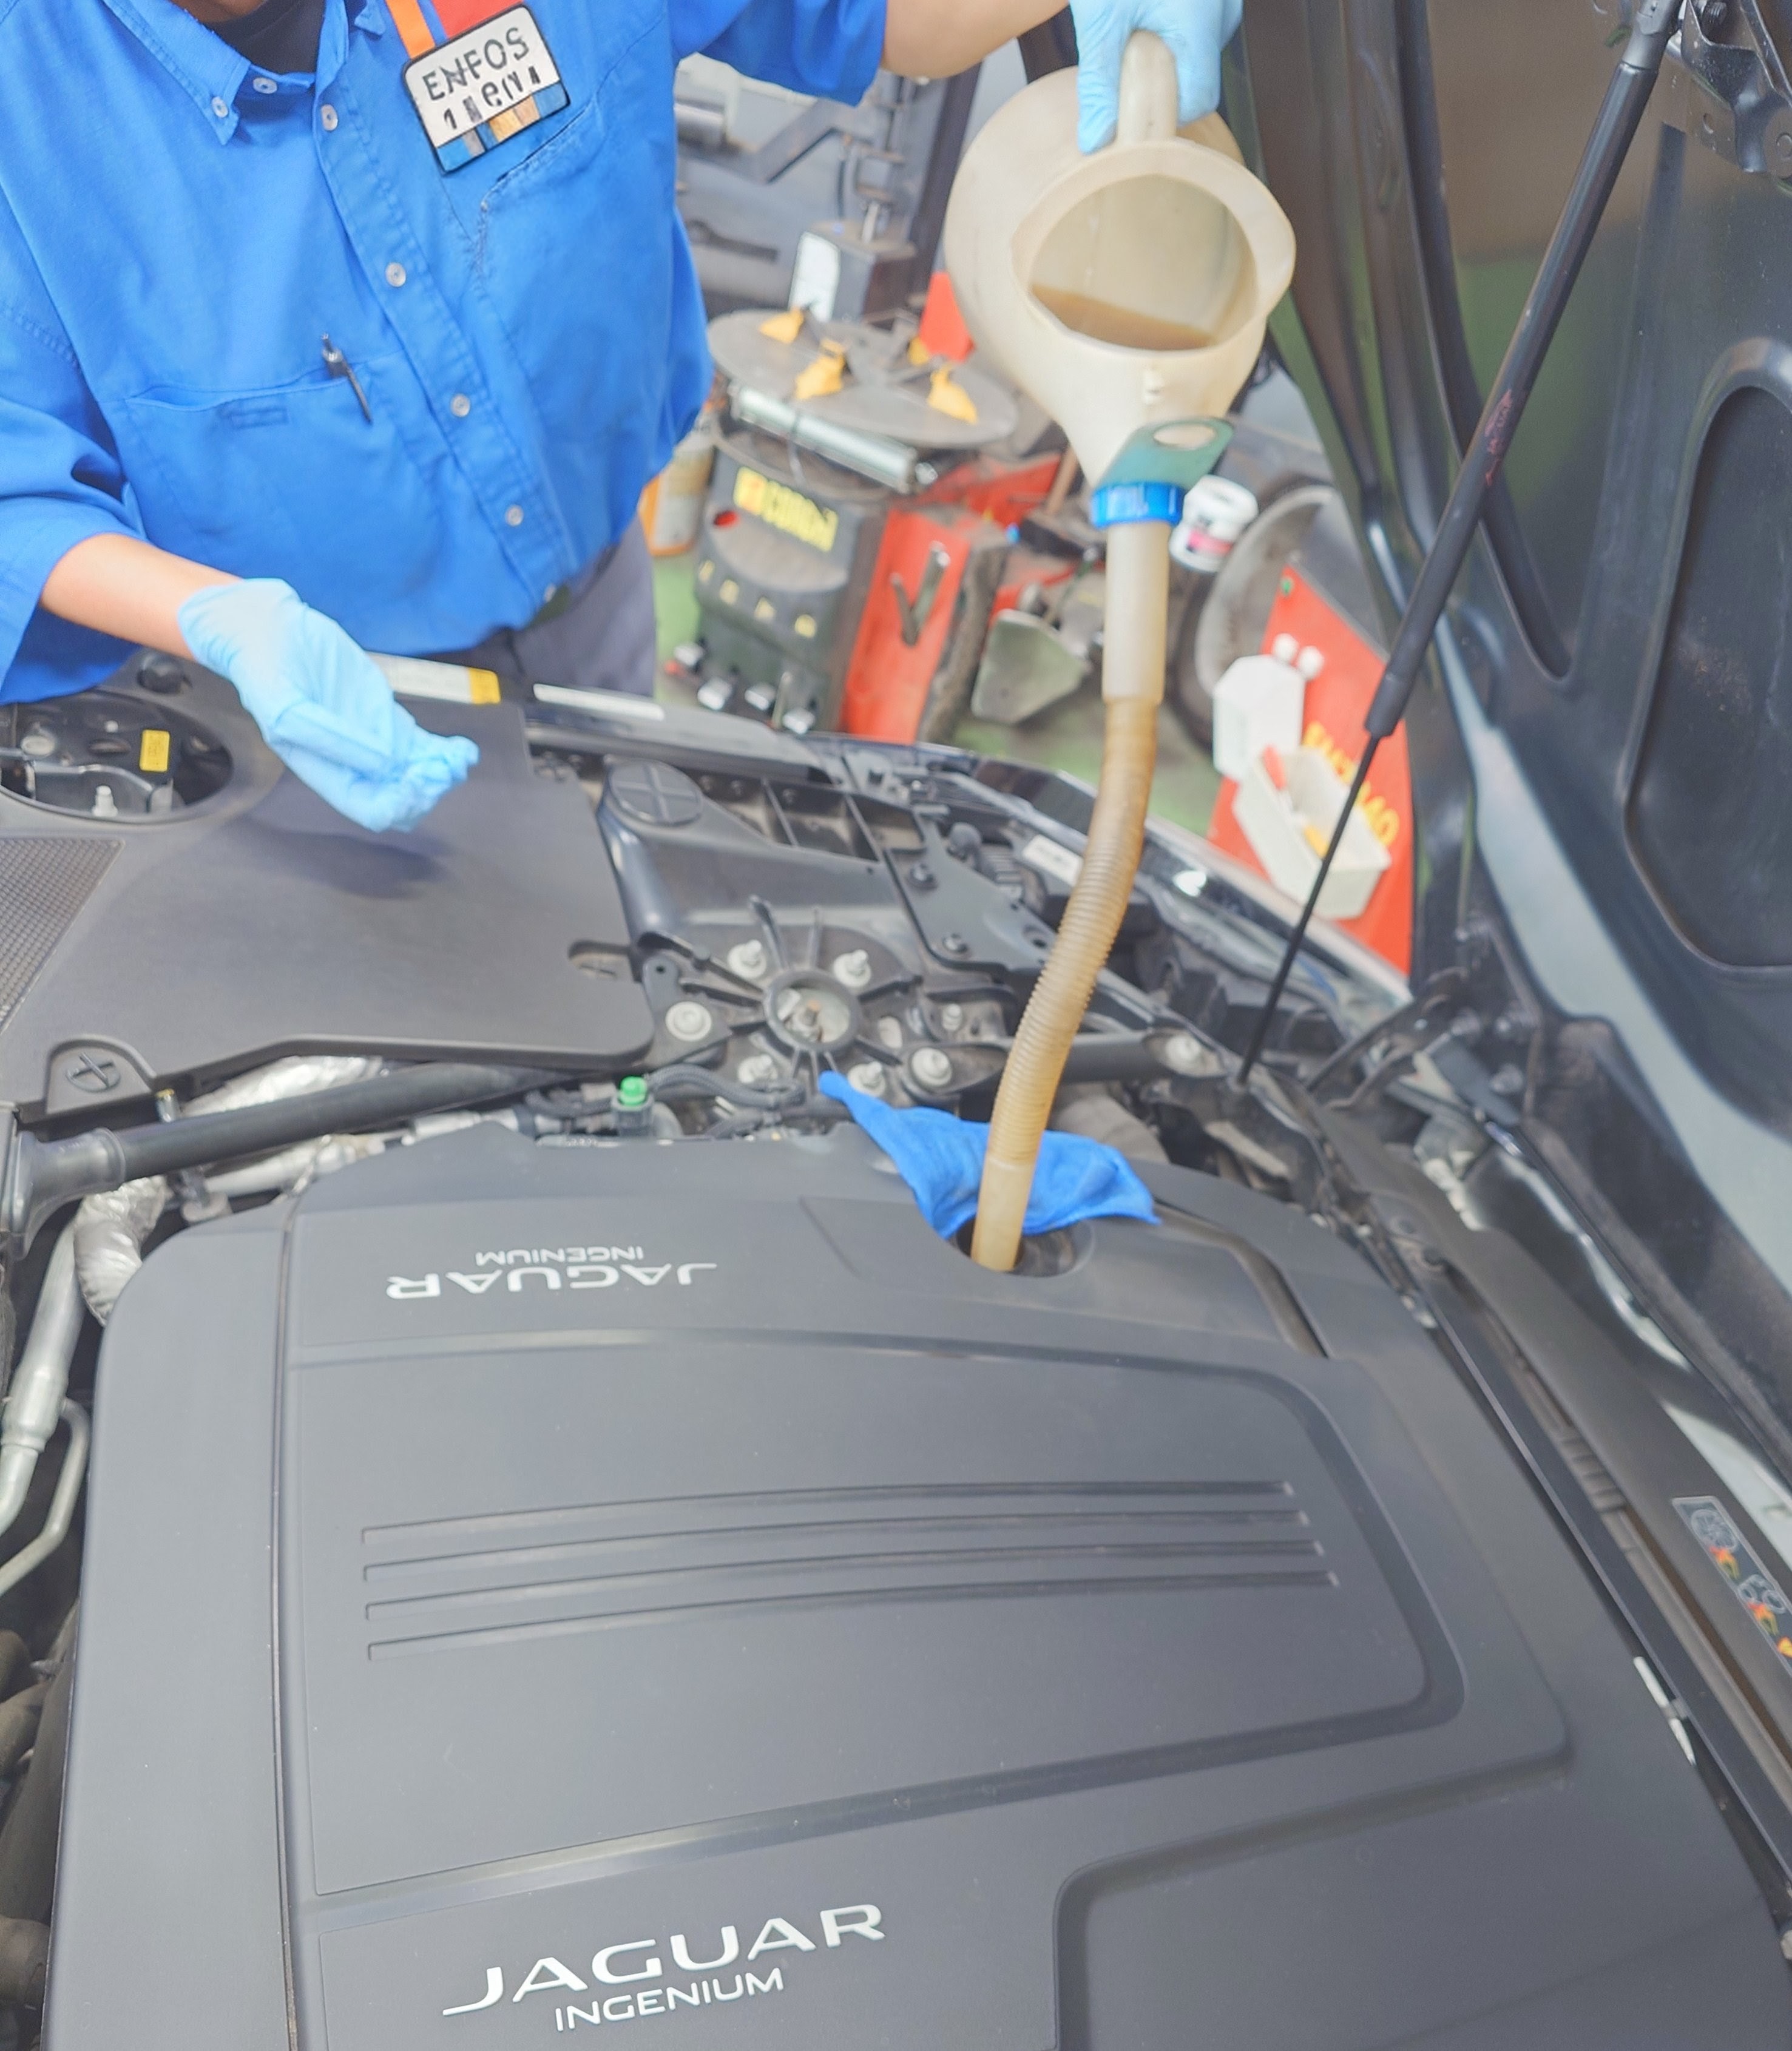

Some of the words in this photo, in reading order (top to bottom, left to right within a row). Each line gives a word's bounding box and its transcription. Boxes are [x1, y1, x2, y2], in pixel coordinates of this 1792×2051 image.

[386, 1263, 717, 1300] JAGUAR
[475, 1246, 644, 1266] INGENIUM
[442, 1903, 885, 2016] JAGUAR
[555, 1967, 784, 2032] INGENIUM
